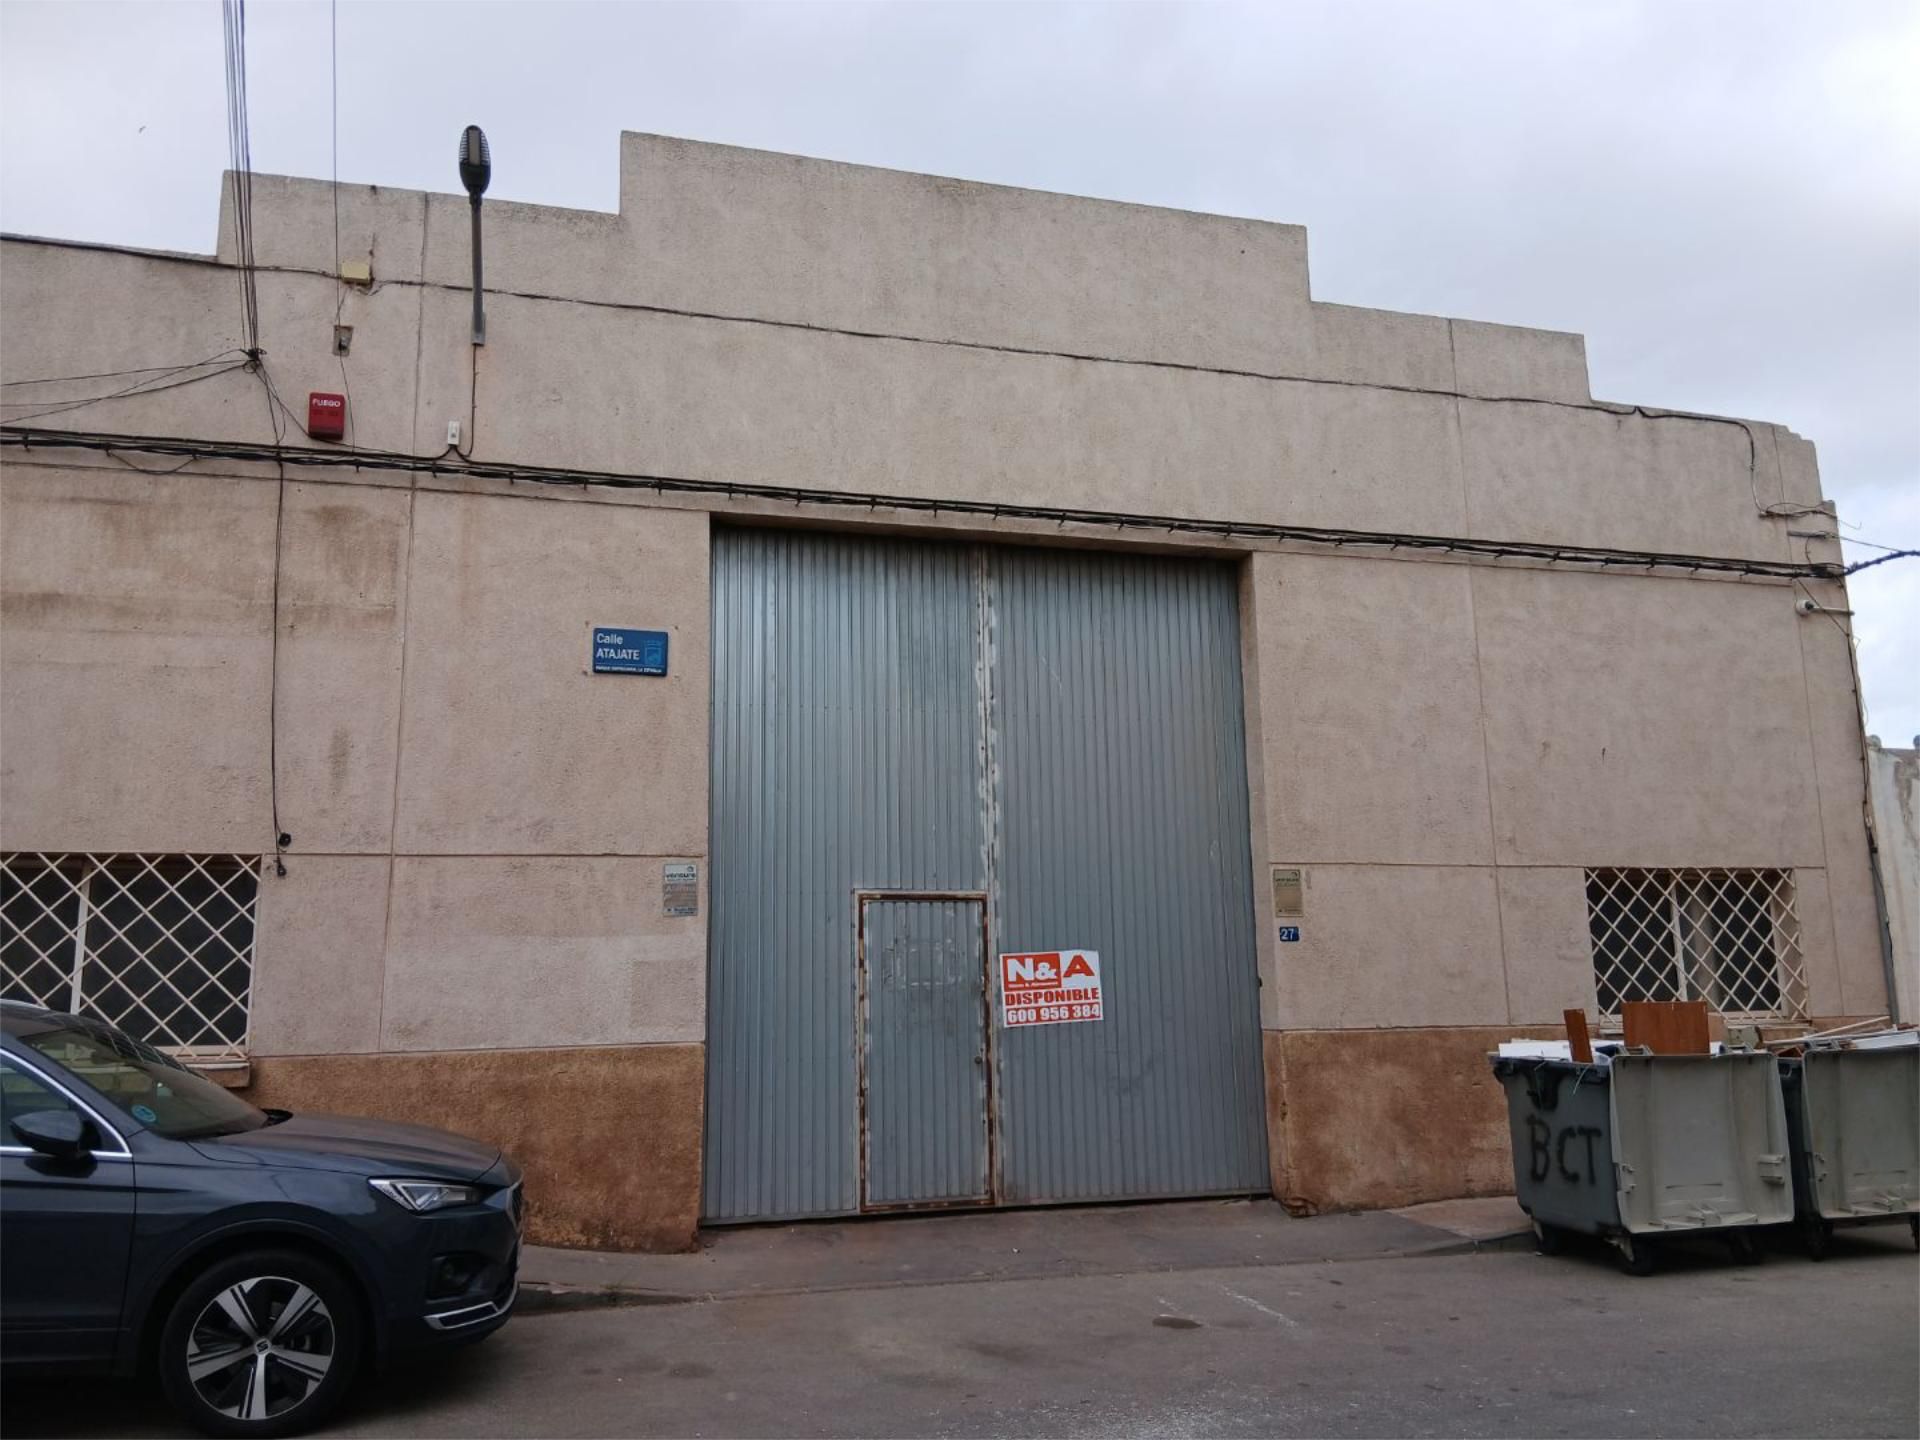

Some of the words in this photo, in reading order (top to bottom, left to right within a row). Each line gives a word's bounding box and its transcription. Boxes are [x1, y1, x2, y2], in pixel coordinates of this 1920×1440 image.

[596, 632, 624, 645] Calle
[596, 647, 640, 660] ATAJATE
[1280, 928, 1295, 941] 27
[1007, 953, 1096, 982] N&A
[1005, 987, 1100, 1006] DISPONIBLE
[1007, 1008, 1037, 1023] 600
[1040, 1006, 1069, 1021] 956
[1072, 1003, 1100, 1018] 384
[1526, 1114, 1603, 1187] BCT
